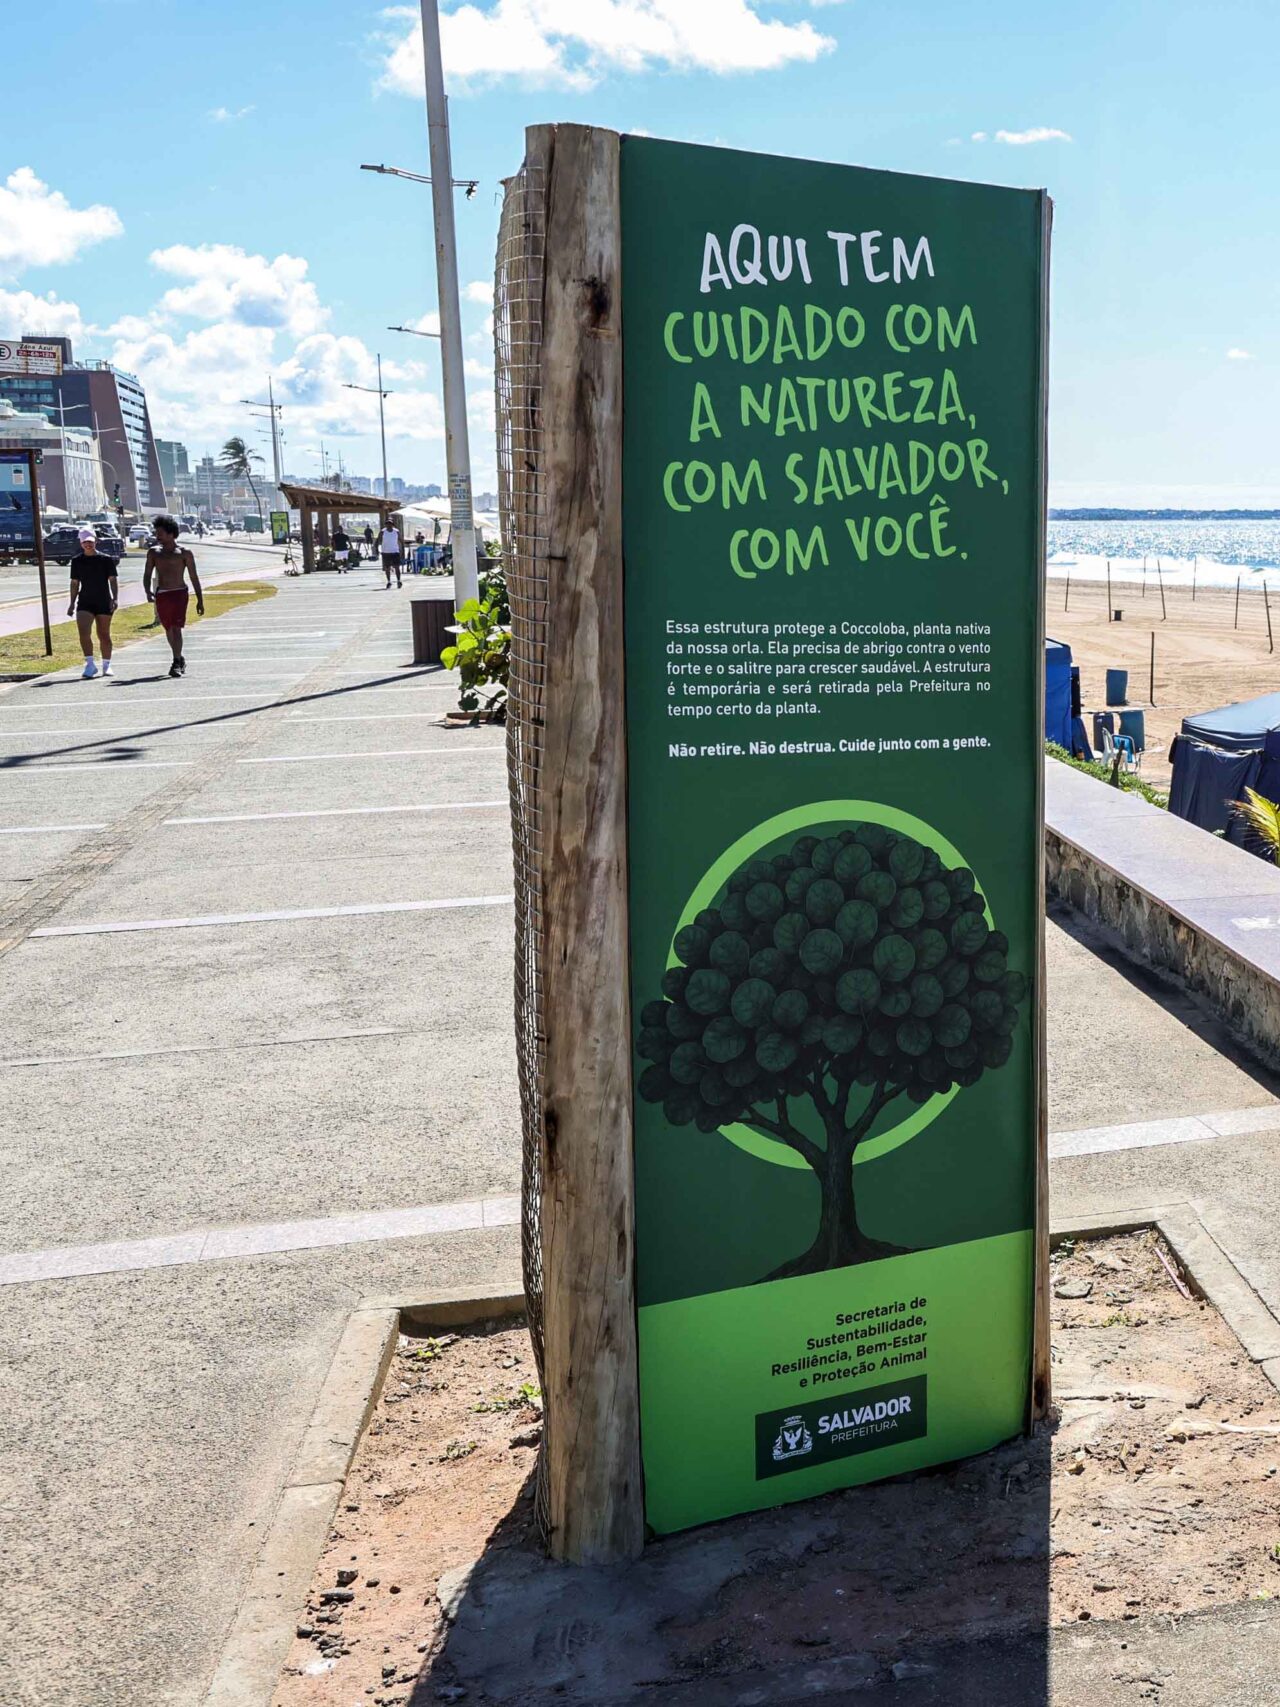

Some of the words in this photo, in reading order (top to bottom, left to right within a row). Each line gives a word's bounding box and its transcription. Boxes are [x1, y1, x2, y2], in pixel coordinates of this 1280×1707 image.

[700, 224, 812, 293] AQUI
[827, 230, 935, 286] TEM
[664, 304, 865, 364] CUIDADO
[886, 304, 977, 352] COM
[690, 382, 721, 442] A
[741, 369, 976, 436] NATUREZA,
[664, 459, 767, 512] COM
[785, 439, 1009, 505] SALVADOR,
[730, 525, 829, 578] COM
[845, 494, 967, 561] VOCÊ.
[667, 620, 699, 633] Essa
[704, 622, 769, 634] estrutura
[774, 623, 825, 637] protege
[829, 625, 836, 634] a
[842, 622, 908, 636] Coccoloba,
[914, 622, 951, 637] planta
[956, 623, 990, 634] nativa
[667, 641, 682, 654] da
[688, 644, 727, 654] nossa
[732, 641, 763, 654] orla.
[768, 641, 788, 654] Ela
[793, 641, 840, 657] precisa
[844, 642, 859, 654] de
[863, 641, 902, 657] abrigo
[907, 643, 945, 653] contra
[949, 645, 955, 653] o
[959, 643, 990, 653] vento
[667, 662, 700, 674] forte
[705, 665, 712, 674] e
[717, 665, 724, 674] o
[728, 662, 772, 674] salitre
[776, 665, 805, 677] para
[809, 664, 858, 673] crescer
[861, 660, 920, 673] saudável.
[923, 661, 932, 672] A
[935, 661, 990, 672] estrutura
[668, 682, 675, 695] é
[683, 681, 760, 698] temporária
[768, 685, 775, 694] e
[783, 680, 811, 694] será
[819, 681, 869, 693] retirada
[877, 681, 902, 695] pela
[910, 680, 970, 692] Prefeitura
[977, 682, 990, 690] no
[668, 704, 712, 718] tempo
[716, 703, 751, 715] certo
[756, 702, 771, 714] da
[776, 701, 820, 717] planta.
[669, 743, 696, 757] Não
[701, 743, 745, 756] retire.
[750, 741, 775, 754] Não
[779, 741, 835, 753] destrua.
[839, 739, 875, 752] Cuide
[878, 738, 911, 753] junto
[914, 739, 939, 749] com
[943, 739, 949, 748] a
[953, 736, 990, 750] gente.
[836, 1301, 906, 1326] Secretaria
[910, 1296, 927, 1310] de
[807, 1315, 927, 1350] Sustentabilidade,
[772, 1350, 852, 1376] Resiliência,
[857, 1332, 927, 1358] Bem-Estar
[799, 1378, 807, 1387] e
[813, 1361, 875, 1385] Proteção
[880, 1347, 927, 1369] Animal
[818, 1396, 912, 1434] SALVADOR
[832, 1420, 898, 1444] PREFEITURA
